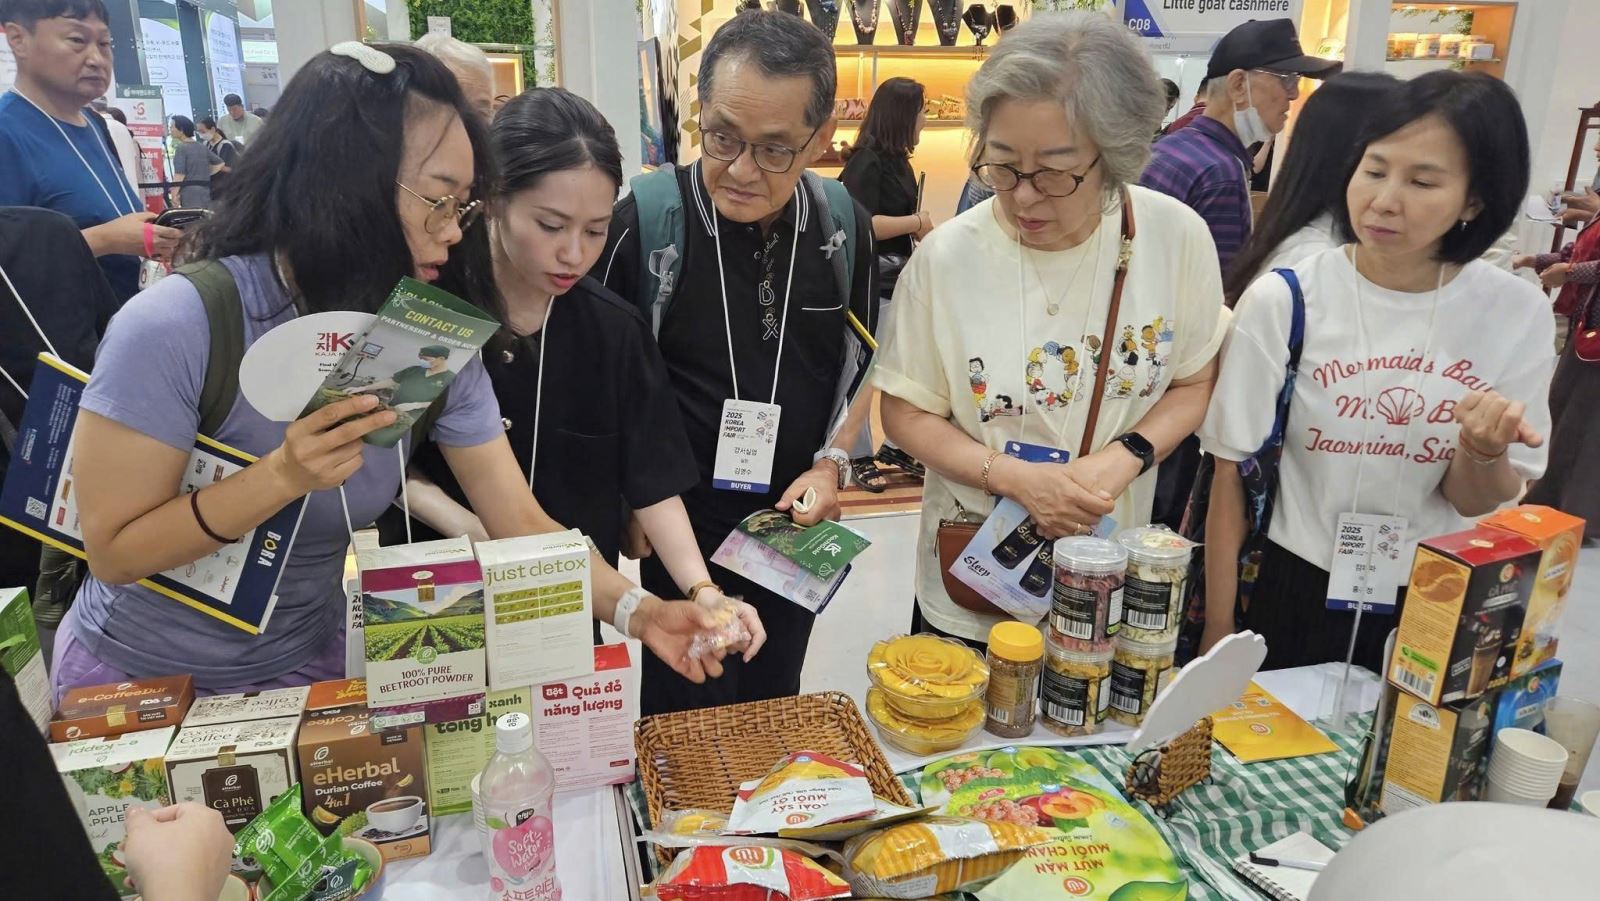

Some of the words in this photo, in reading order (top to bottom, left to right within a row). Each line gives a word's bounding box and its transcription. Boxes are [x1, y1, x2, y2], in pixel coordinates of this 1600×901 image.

[1163, 0, 1195, 10] Little
[1199, 0, 1225, 14] goat
[1229, 0, 1289, 11] cashmere
[1128, 18, 1151, 31] C08
[380, 315, 431, 337] PARTNERSHIP
[405, 310, 458, 333] CONTACT
[457, 326, 475, 338] US
[724, 419, 744, 427] KOREA
[725, 411, 743, 419] 2025
[730, 482, 752, 490] BUYER
[1017, 526, 1039, 545] Sleep
[1341, 526, 1362, 534] 2025
[257, 530, 282, 568] BORA
[486, 564, 526, 586] just
[529, 557, 587, 578] detox
[963, 556, 991, 577] Sleep
[402, 667, 426, 680] 100%
[427, 665, 452, 676] PURE
[380, 676, 430, 694] BEETROOT
[432, 673, 474, 685] POWDER
[545, 686, 564, 697] Bột
[572, 682, 601, 699] Quả
[604, 679, 622, 693] đỏ
[78, 686, 169, 704] e-CoffeeDur
[488, 694, 522, 708] xanh
[543, 703, 580, 717] năng
[582, 699, 623, 712] lượng
[306, 714, 356, 727] Coffee
[180, 732, 232, 744] Coffee
[313, 757, 401, 786] eHerbal
[314, 785, 350, 797] Durian
[350, 778, 384, 791] Coffee
[213, 797, 230, 809] Cà
[232, 796, 255, 807] Phê
[793, 793, 827, 803] MUỐI
[770, 804, 794, 815] SẤY
[89, 814, 125, 827] PPLE
[508, 829, 535, 855] Soft
[510, 836, 543, 869] Water
[1023, 846, 1068, 858] CHAN
[1070, 843, 1111, 860] MUỐI
[1073, 859, 1105, 872] MỨT
[502, 876, 556, 901] 소프트워터
